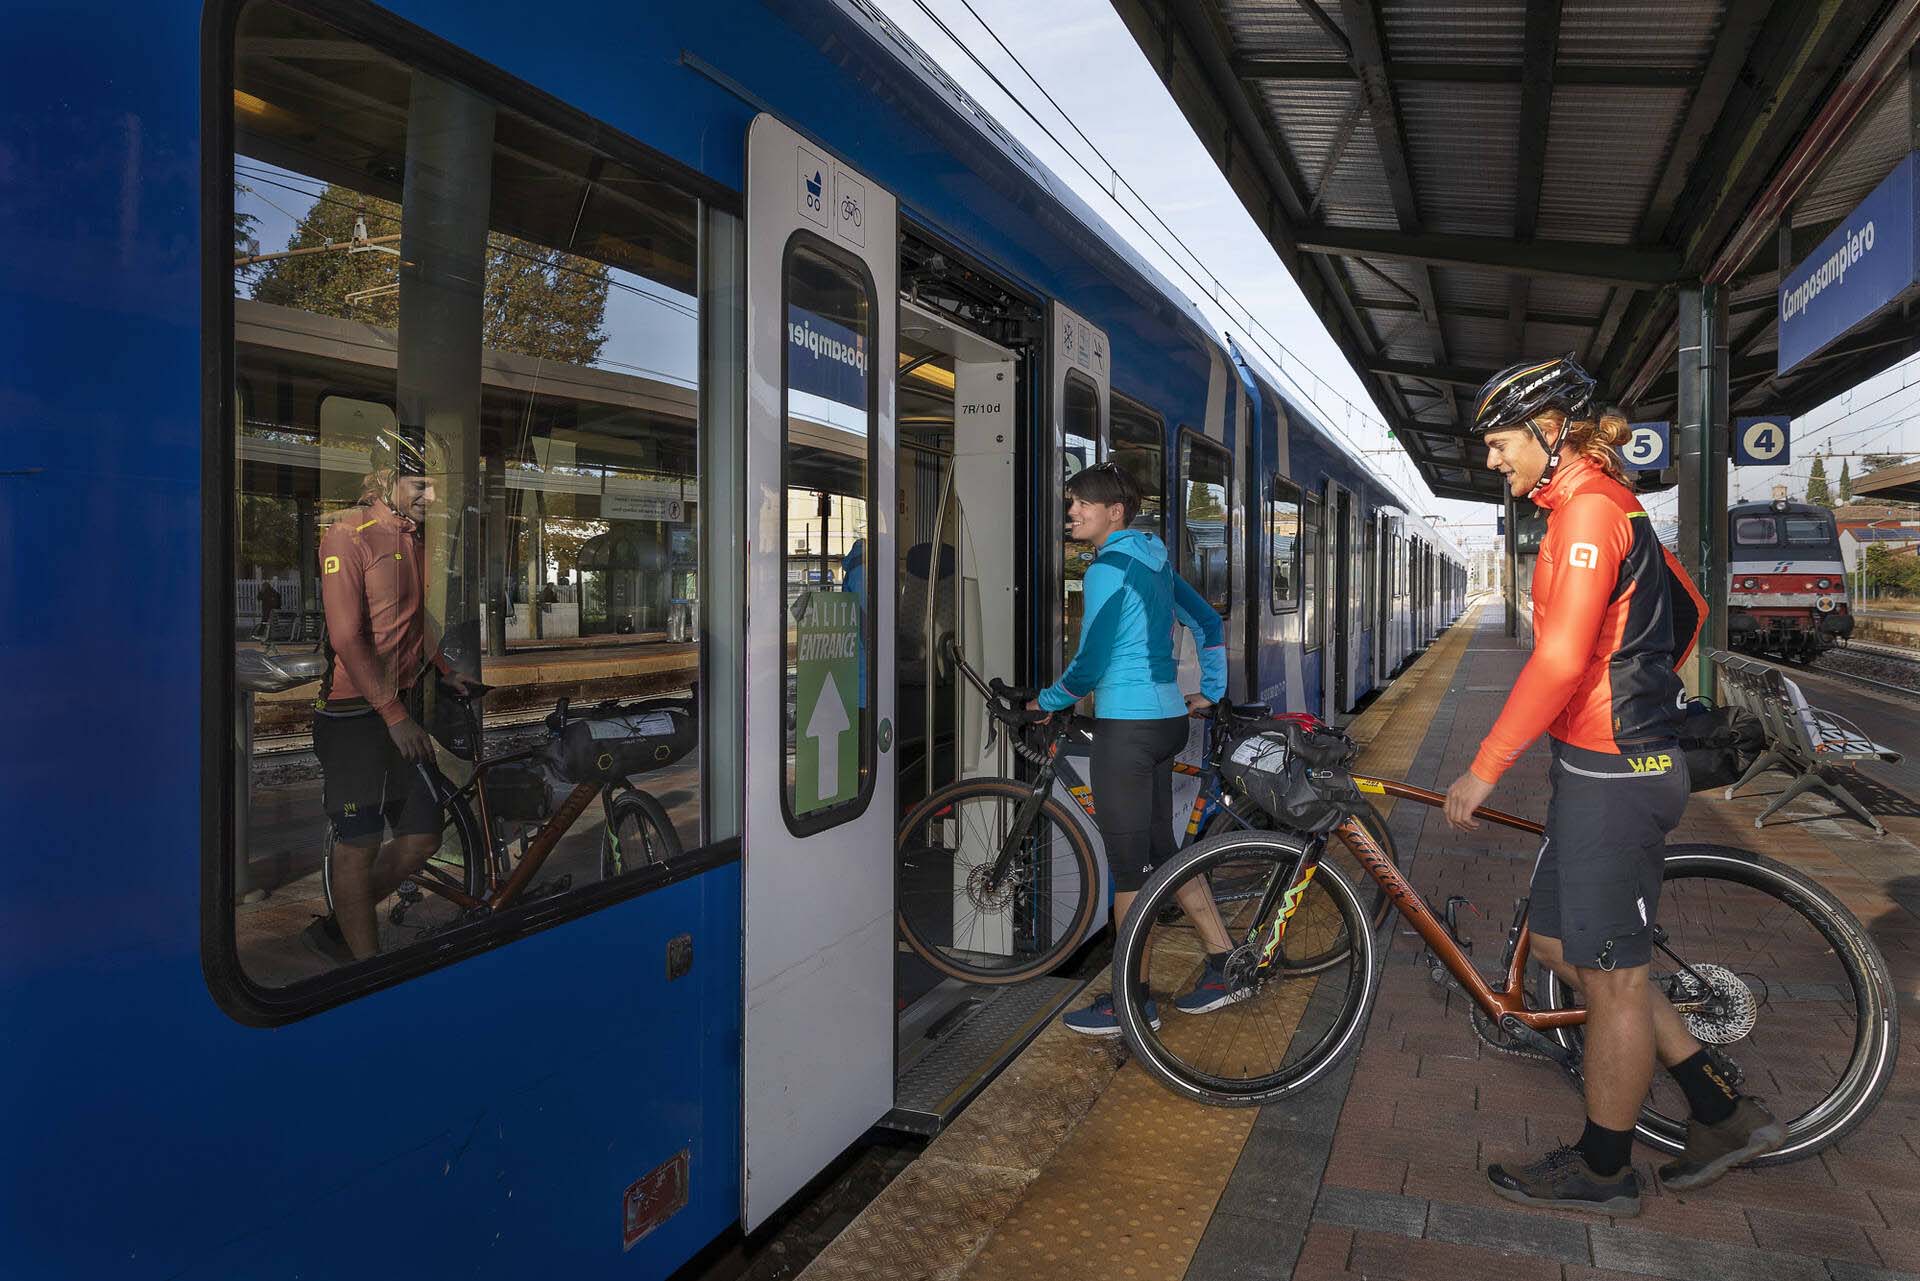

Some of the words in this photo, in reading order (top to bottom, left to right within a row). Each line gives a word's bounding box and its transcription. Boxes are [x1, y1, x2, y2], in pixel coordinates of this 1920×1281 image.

[1782, 221, 1875, 322] Camposampiero
[962, 403, 1001, 414] 7R/10d
[1632, 434, 1652, 458] 5
[1753, 429, 1776, 453] 4
[799, 632, 857, 661] ENTRANCE
